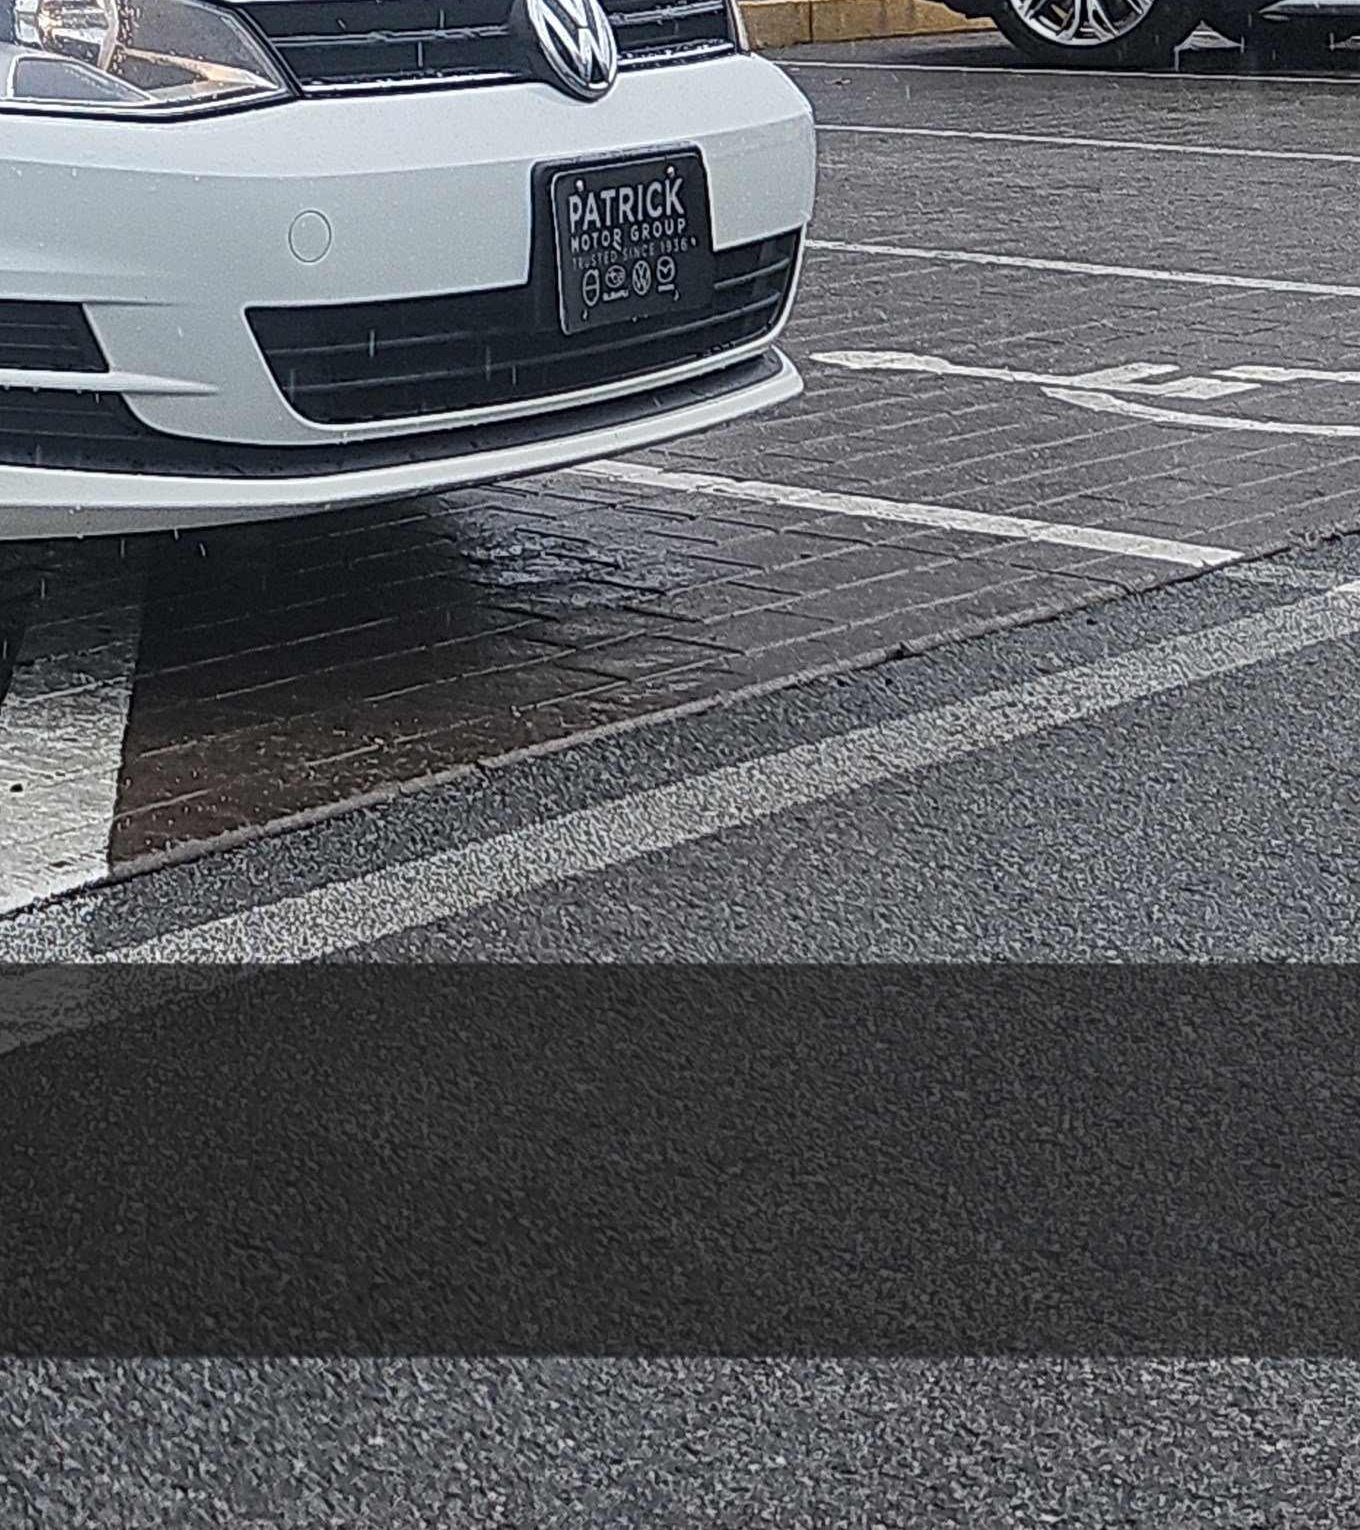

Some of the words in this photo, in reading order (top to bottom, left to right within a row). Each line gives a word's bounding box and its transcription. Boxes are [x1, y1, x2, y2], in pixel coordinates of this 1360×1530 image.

[568, 178, 685, 233] PATRICK
[570, 227, 623, 254] MOTOR
[630, 217, 686, 242] GROUP
[622, 241, 656, 263] SINCE
